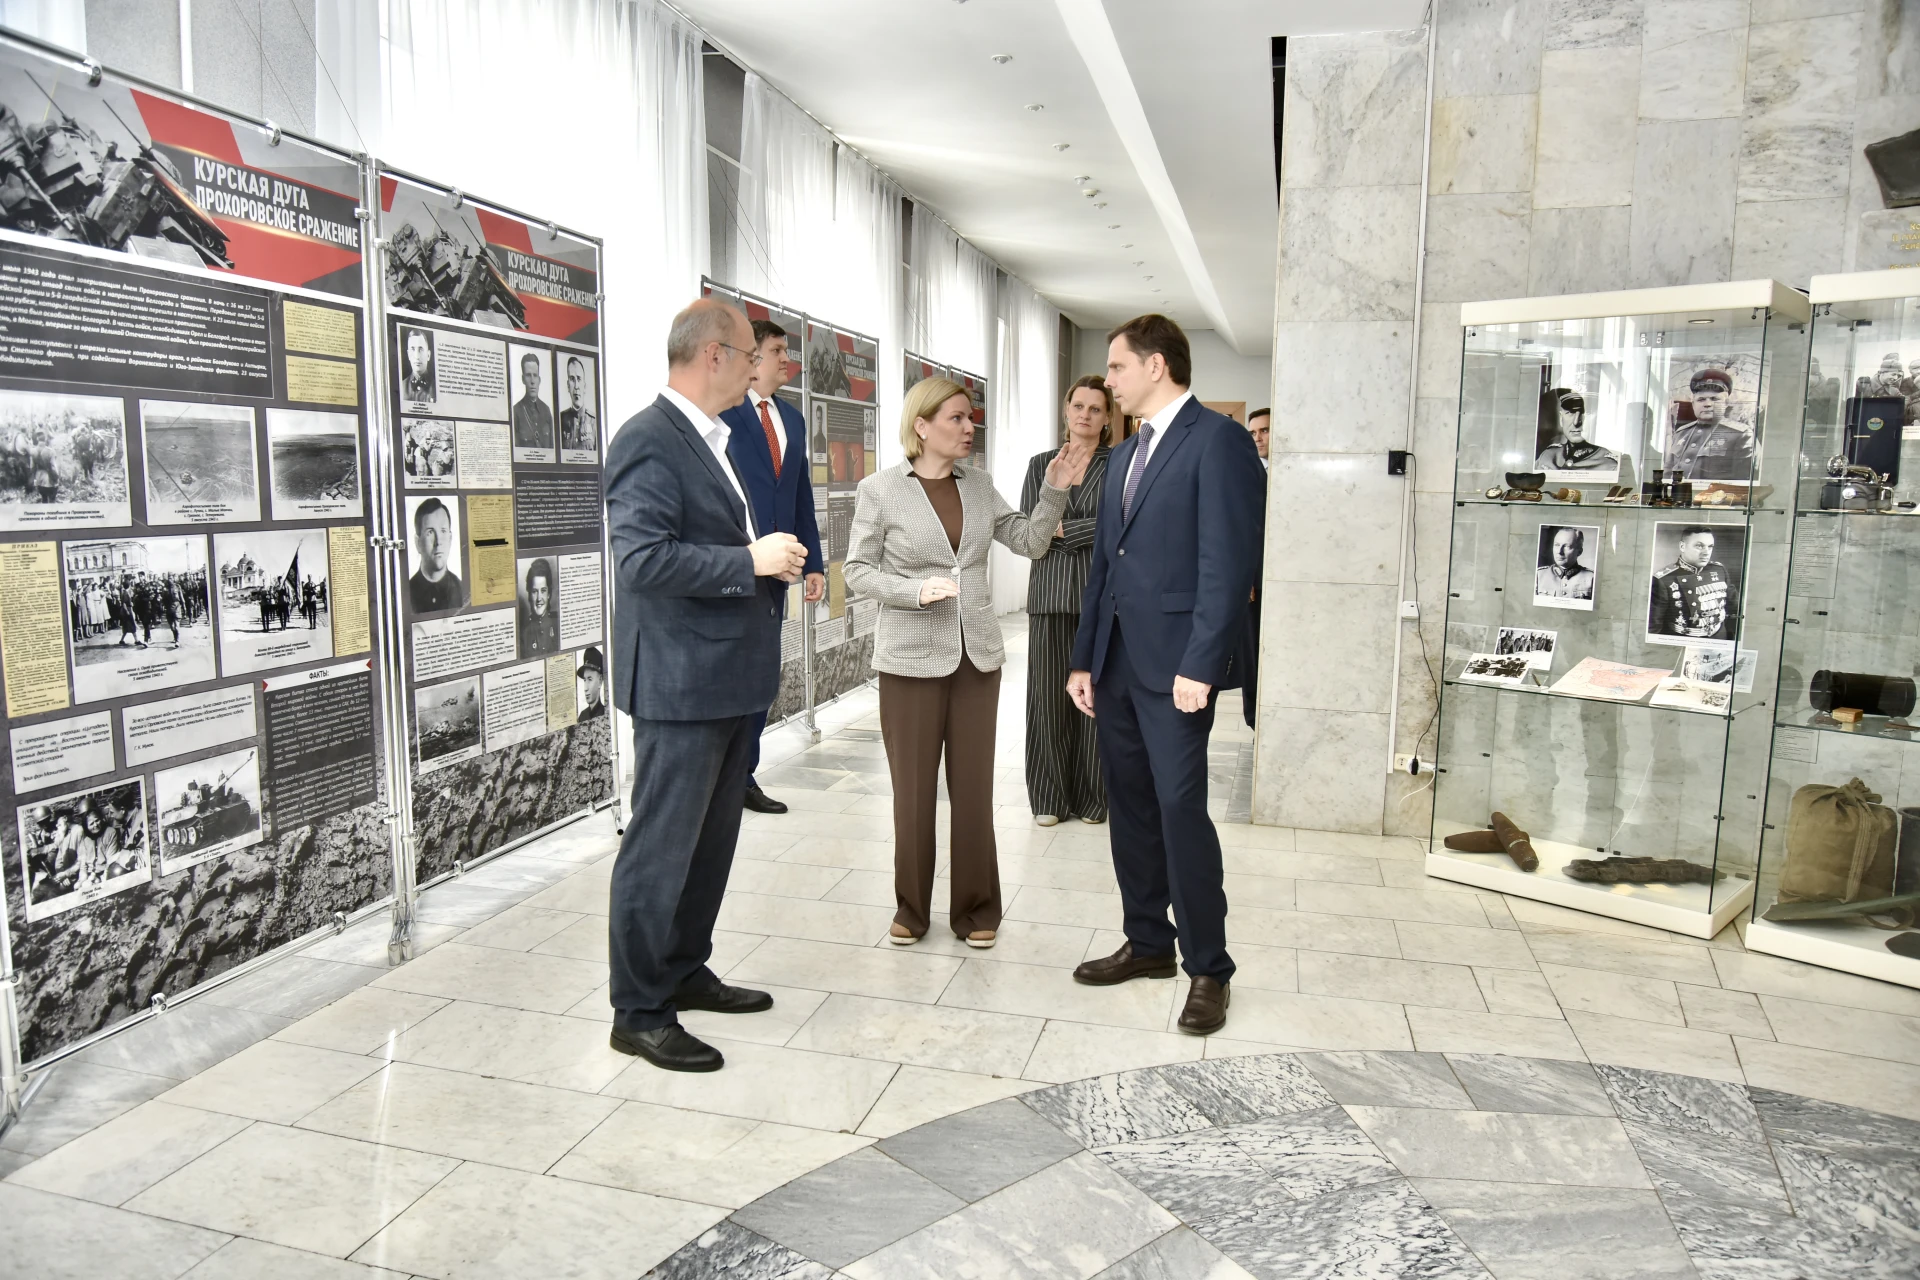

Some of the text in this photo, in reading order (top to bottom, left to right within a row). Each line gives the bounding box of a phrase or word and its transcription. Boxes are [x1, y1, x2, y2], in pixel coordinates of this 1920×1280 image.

[194, 156, 310, 210] КУРСКАЯ ДУГА
[195, 185, 358, 248] ПРОХОРОВСКОЕ СРАЖЕНИЕ
[508, 251, 570, 284] КУРСКАЯ ДУГА
[508, 271, 596, 308] ПРОХОРОВСКОЕ СРАЖЕНИЕ
[308, 670, 330, 680] ФАКТЫ:
